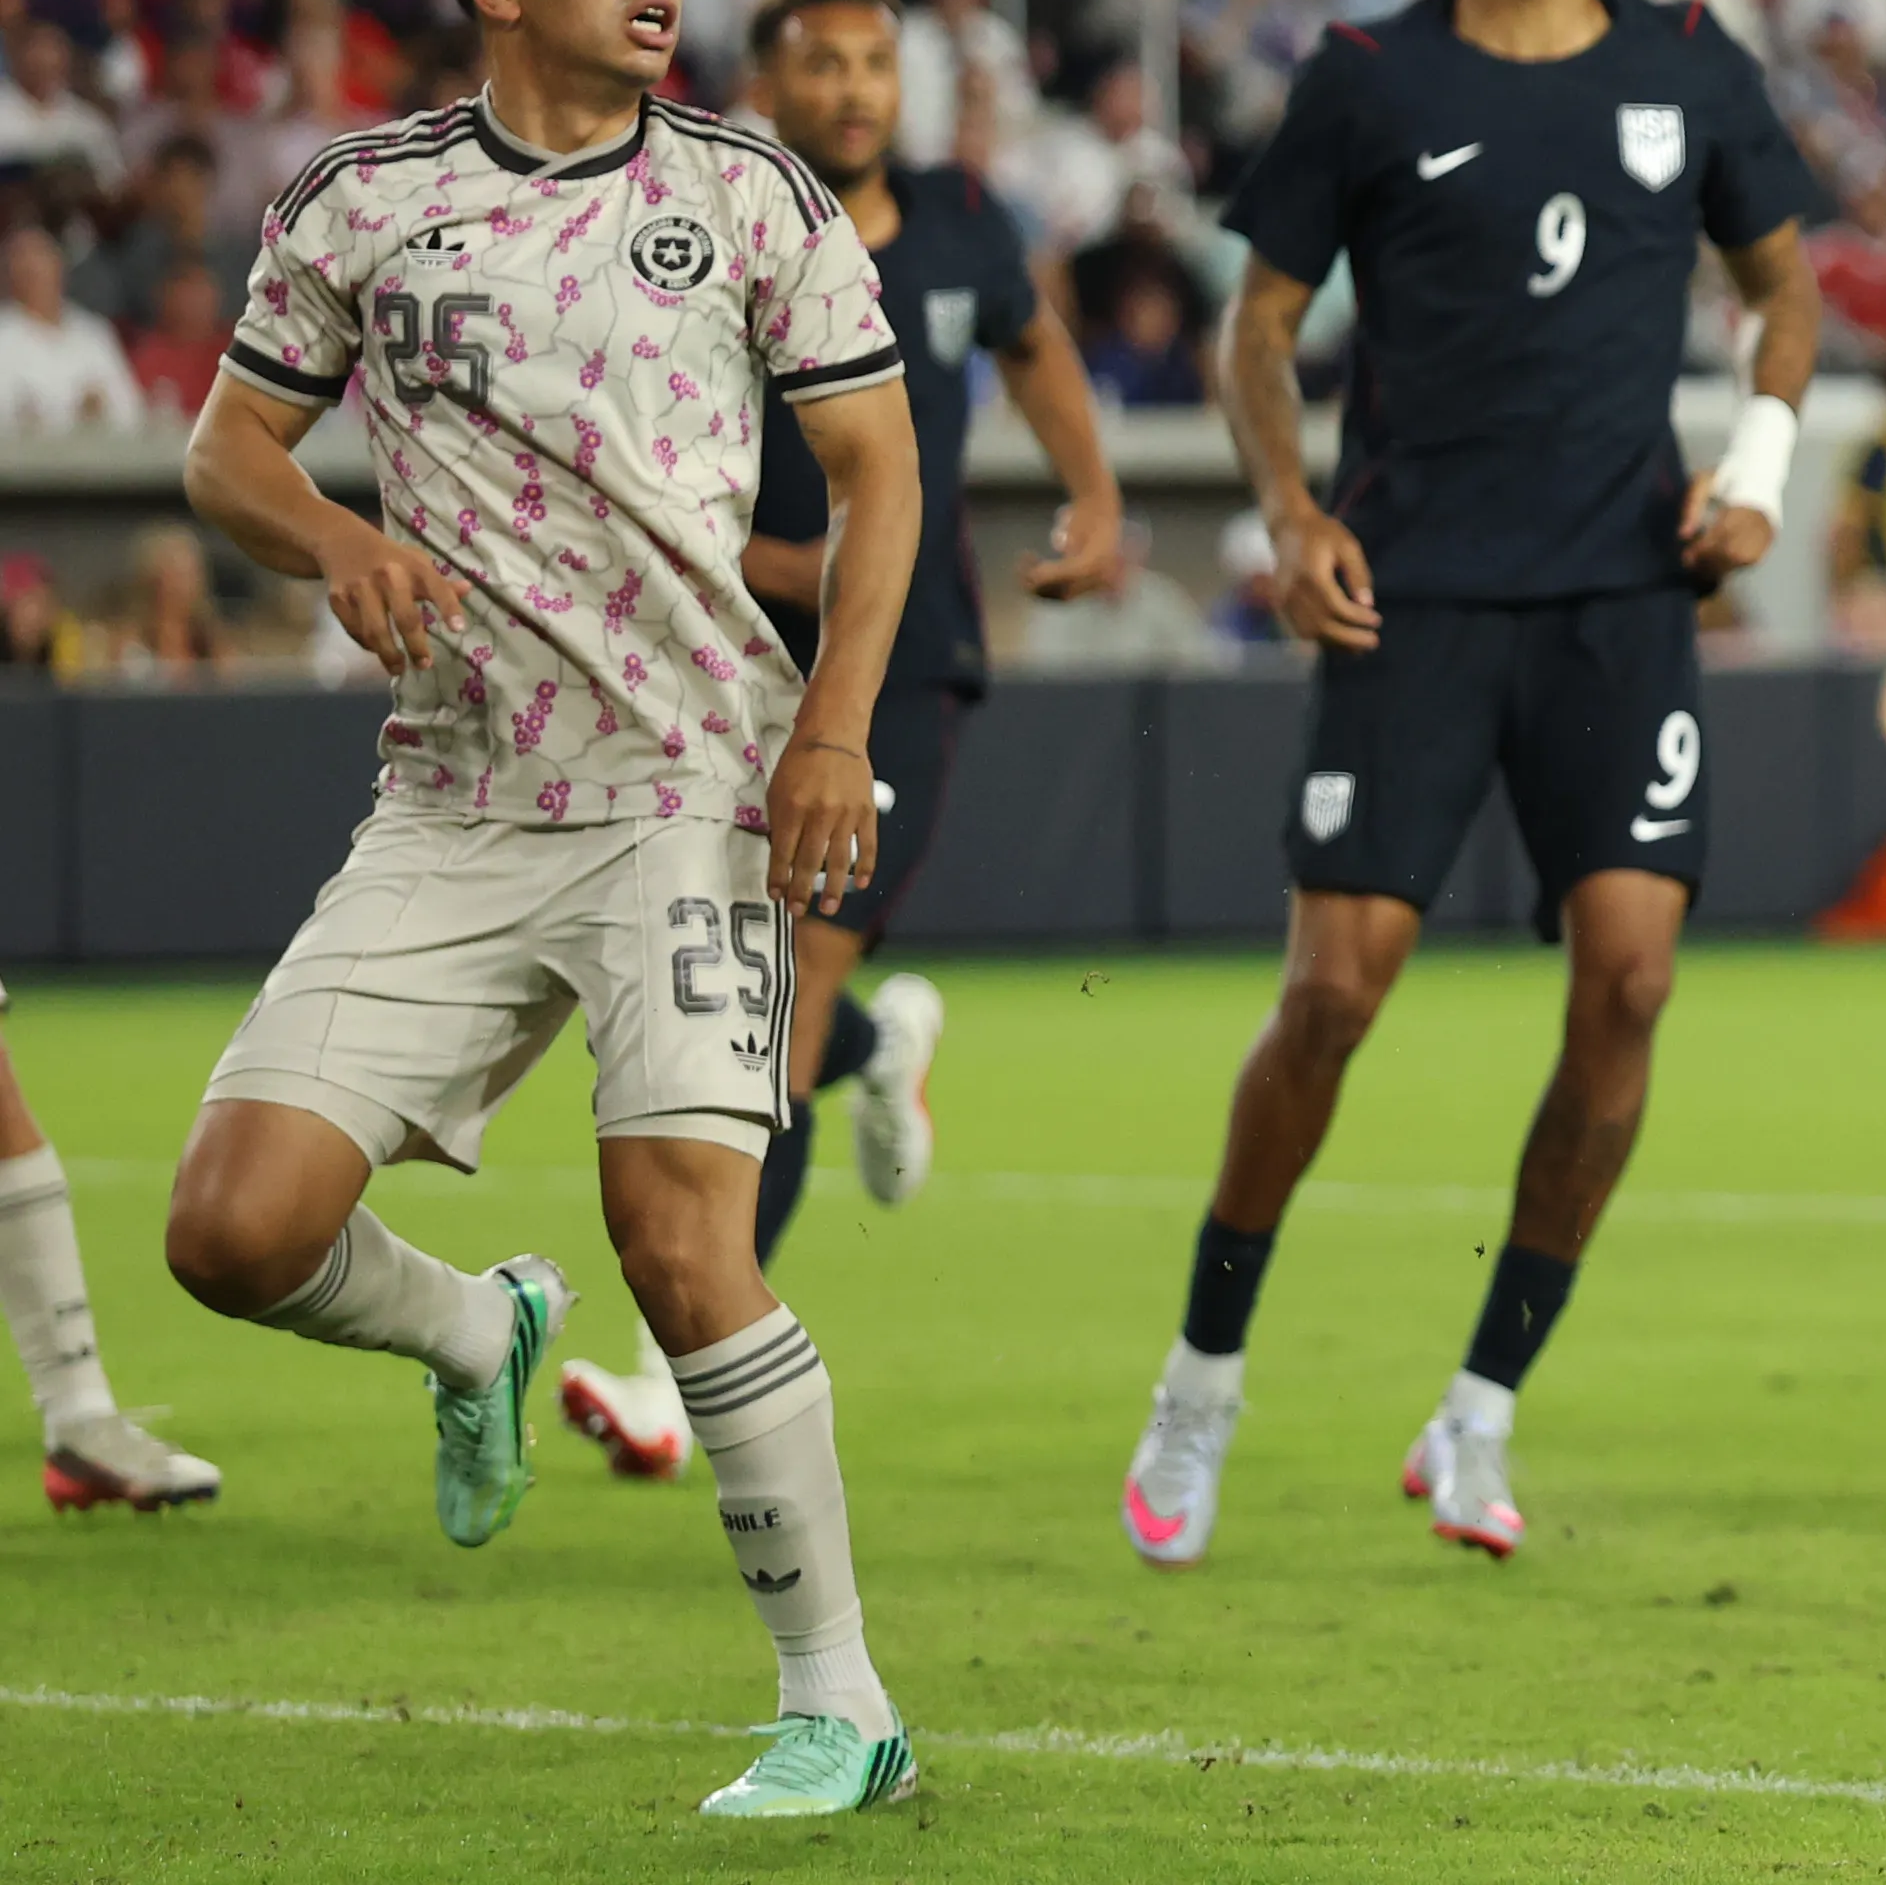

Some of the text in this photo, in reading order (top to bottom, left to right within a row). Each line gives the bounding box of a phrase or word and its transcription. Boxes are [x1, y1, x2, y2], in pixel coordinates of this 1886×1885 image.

[1526, 191, 1587, 298] 9
[374, 292, 495, 404] 25
[1644, 709, 1702, 811] 9
[667, 895, 773, 1019] 25
